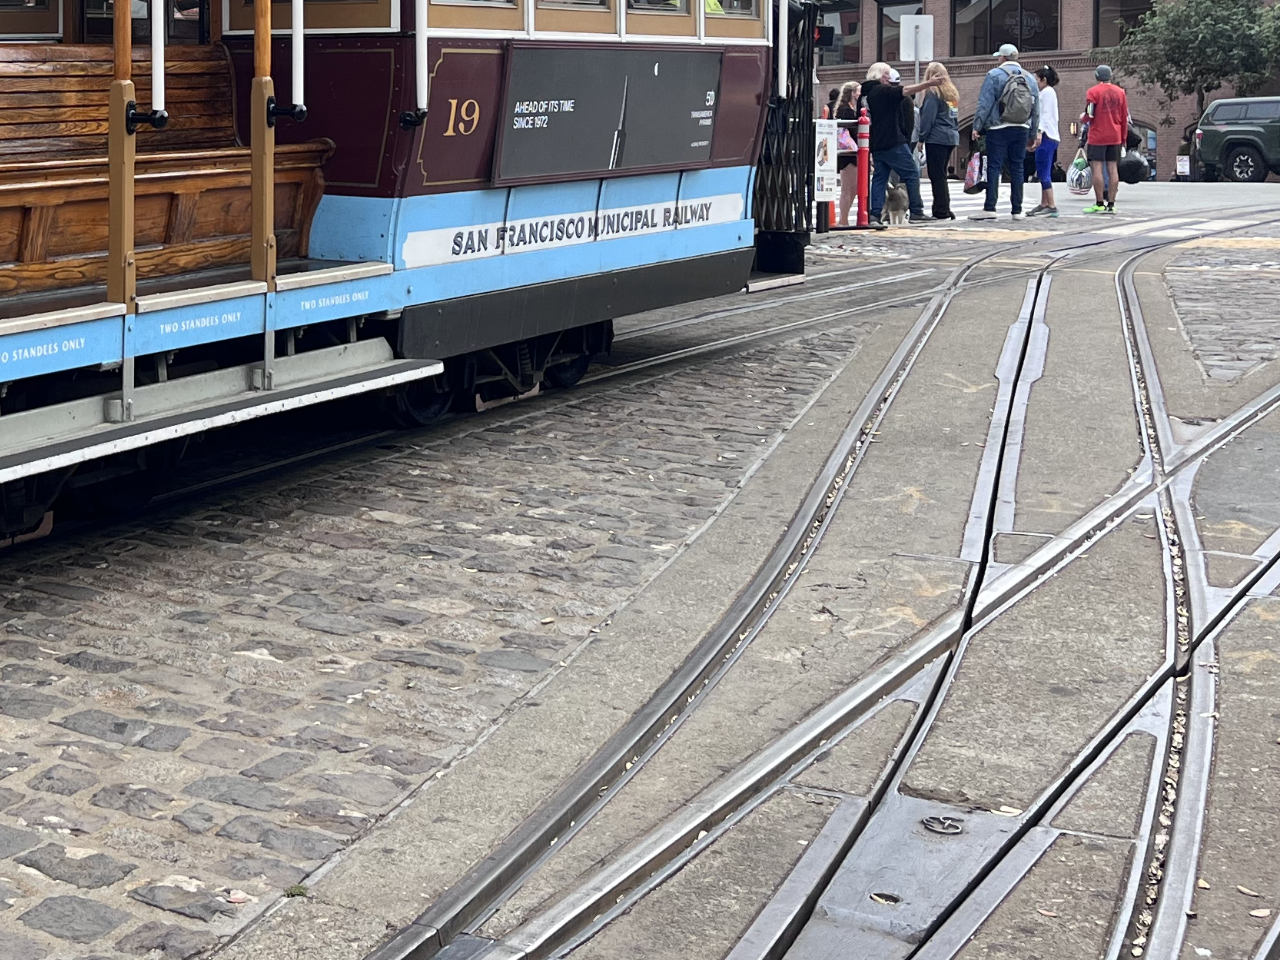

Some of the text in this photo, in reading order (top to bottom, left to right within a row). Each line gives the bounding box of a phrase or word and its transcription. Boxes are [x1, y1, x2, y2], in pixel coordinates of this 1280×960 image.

[442, 98, 480, 136] 19
[514, 99, 575, 114] AHEAD OF ITS TIME
[512, 115, 549, 129] SINCE 1972
[451, 229, 488, 256] SAN
[495, 216, 584, 250] FRANCISCO
[662, 202, 712, 228] RAILWAY
[301, 290, 369, 310] TWO STANDEES ONLY
[160, 311, 241, 334] TWO STANDEES ONLY
[12, 342, 59, 361] STANDEES
[62, 337, 86, 352] ONLY
